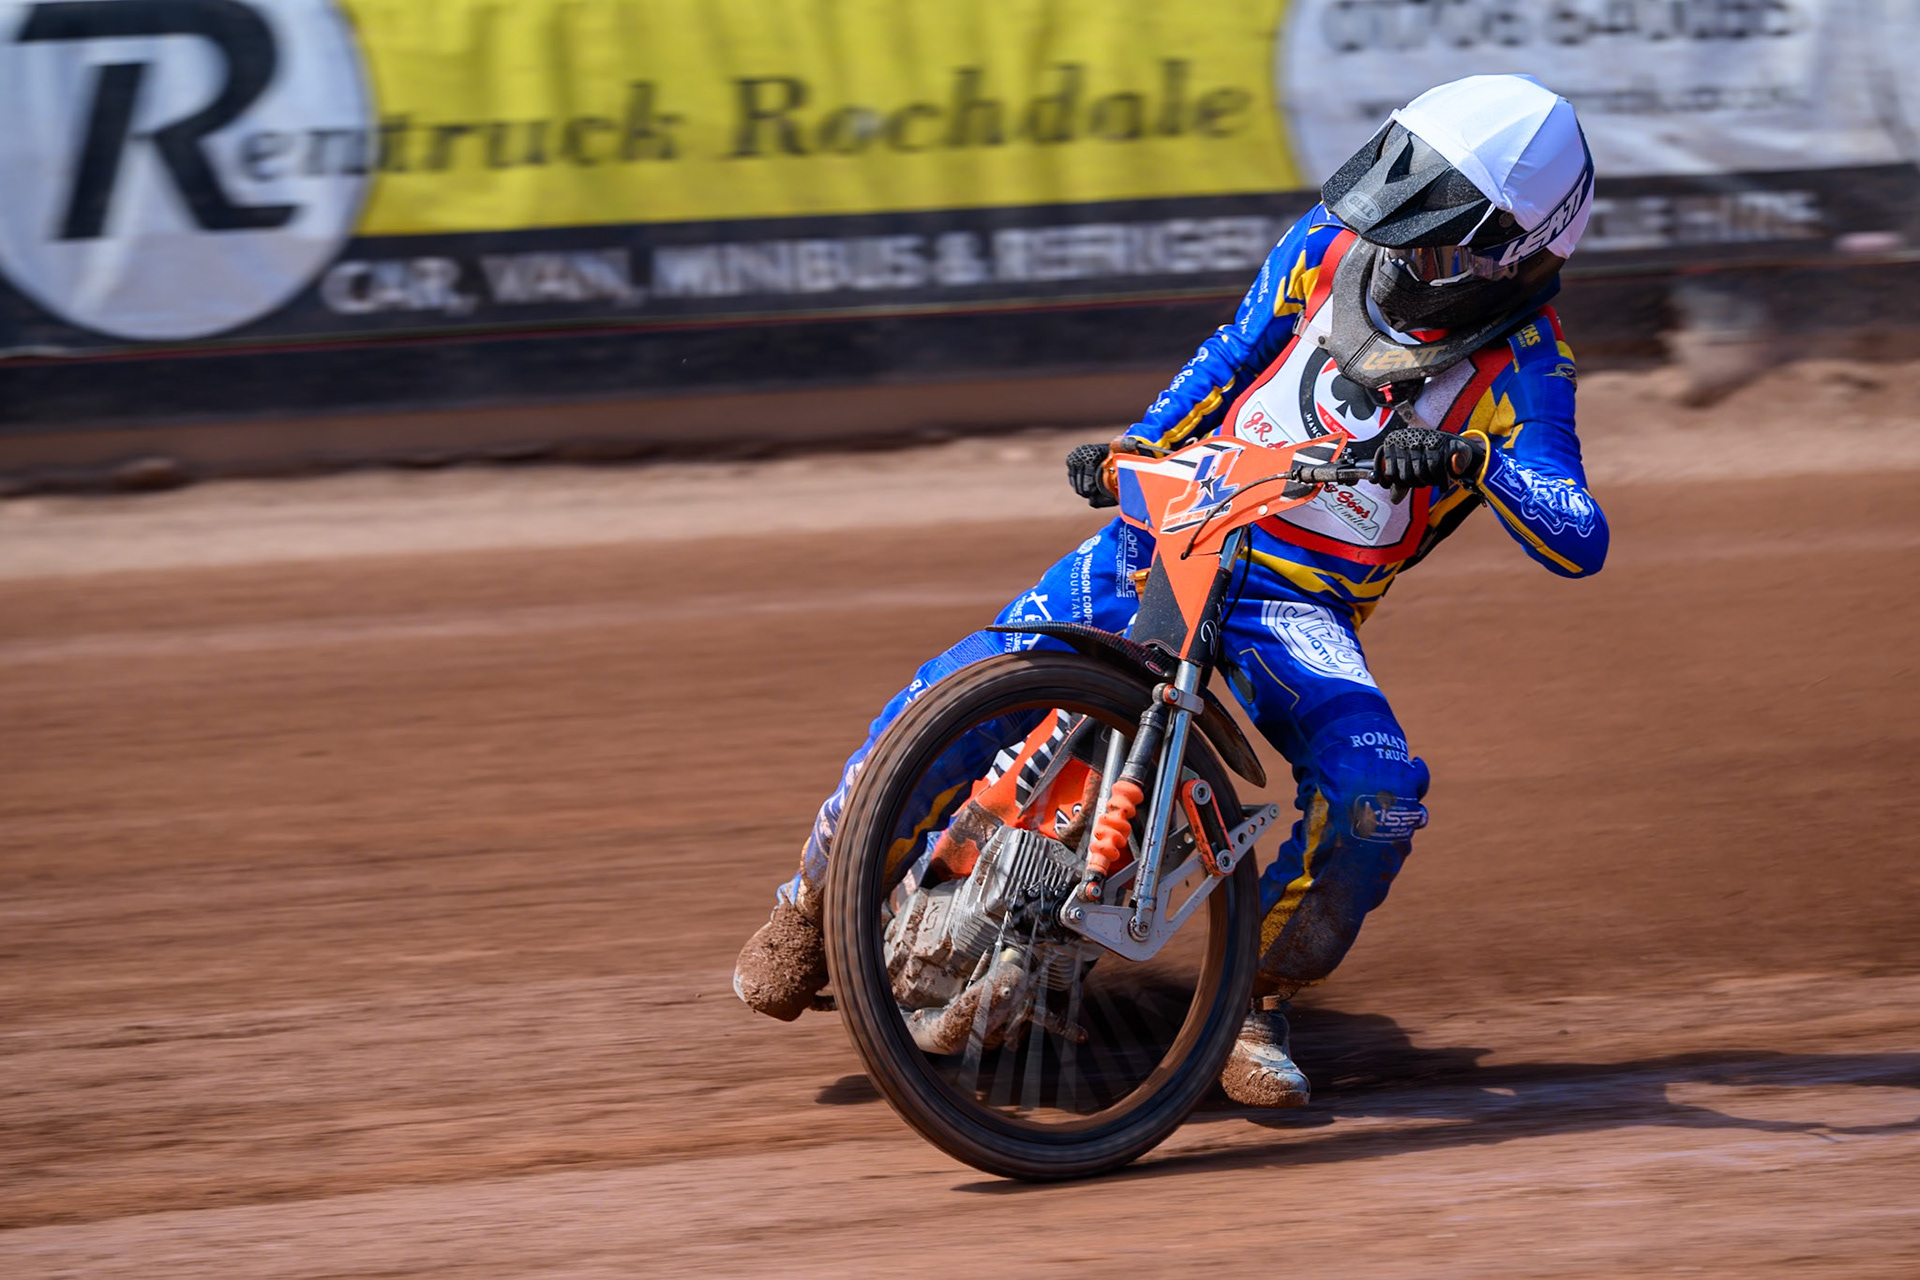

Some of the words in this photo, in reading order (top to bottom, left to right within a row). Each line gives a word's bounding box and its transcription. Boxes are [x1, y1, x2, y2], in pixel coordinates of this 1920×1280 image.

[726, 57, 1254, 160] Rochdale
[1350, 194, 1376, 220] BELL
[1361, 345, 1448, 371] LEATT
[1069, 556, 1082, 624] ACCOUNTAN
[1080, 552, 1094, 594] THOMSON
[1081, 594, 1093, 628] COOPE
